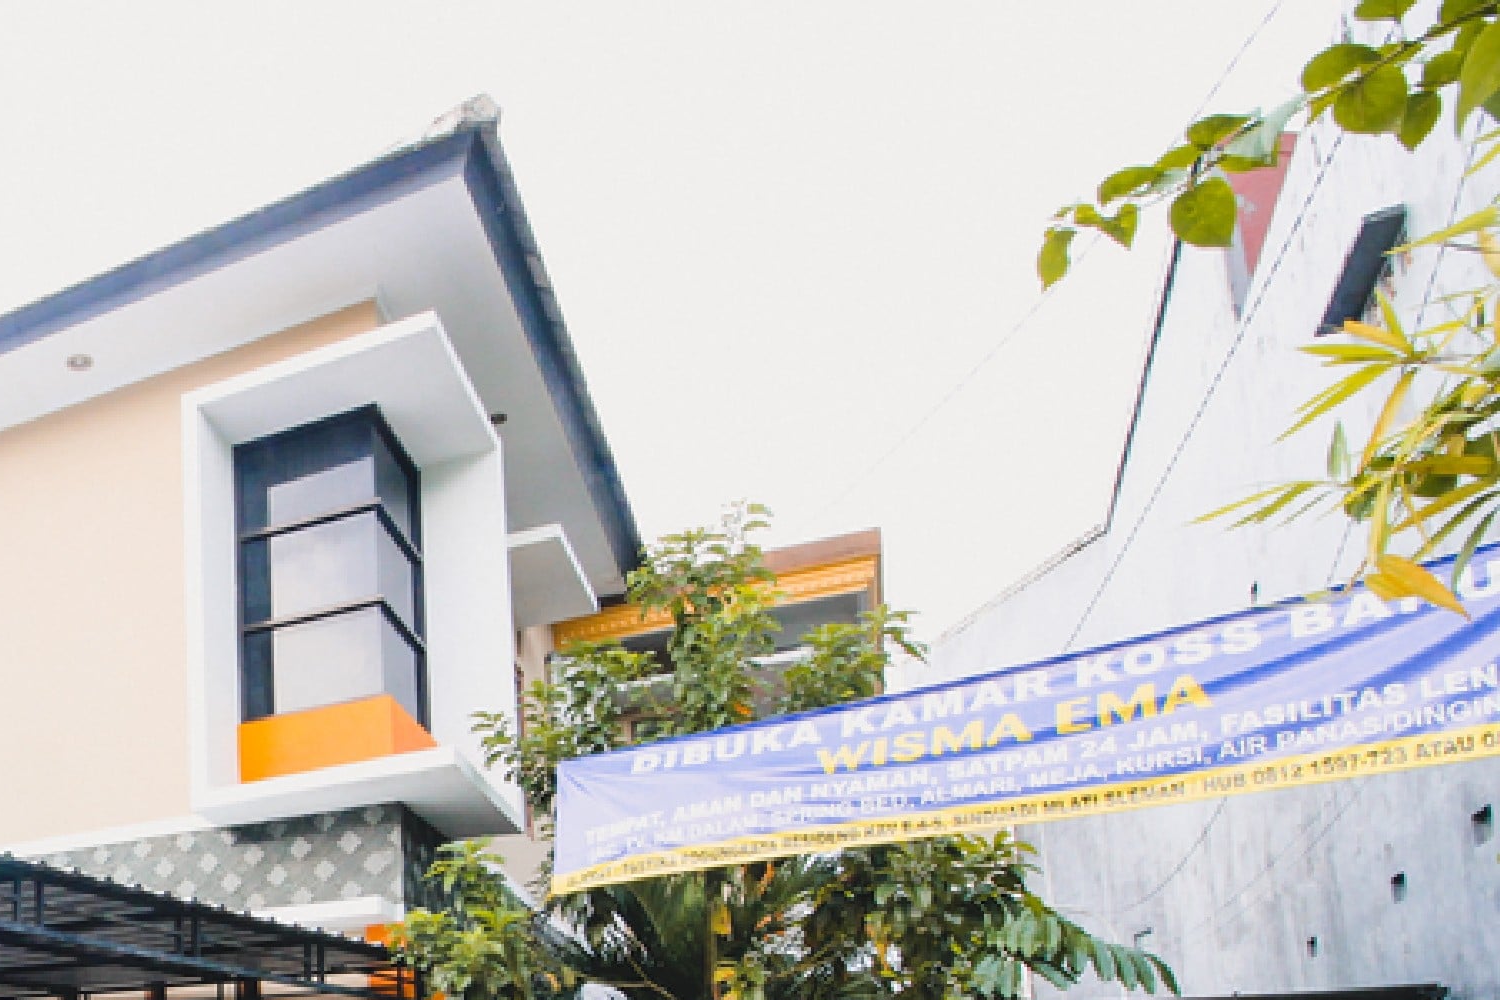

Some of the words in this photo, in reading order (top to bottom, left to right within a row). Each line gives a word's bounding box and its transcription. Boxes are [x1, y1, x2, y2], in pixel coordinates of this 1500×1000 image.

[631, 720, 821, 774] DIBUKA
[840, 671, 1052, 738] KAMAR
[1076, 621, 1262, 688] KOSS
[816, 712, 1033, 775] WISMA
[1055, 673, 1214, 735] EMA
[946, 743, 1068, 780] SATPAM
[1080, 734, 1117, 760] 24
[1220, 682, 1407, 735] FASILITAS
[1220, 734, 1269, 760] AIR
